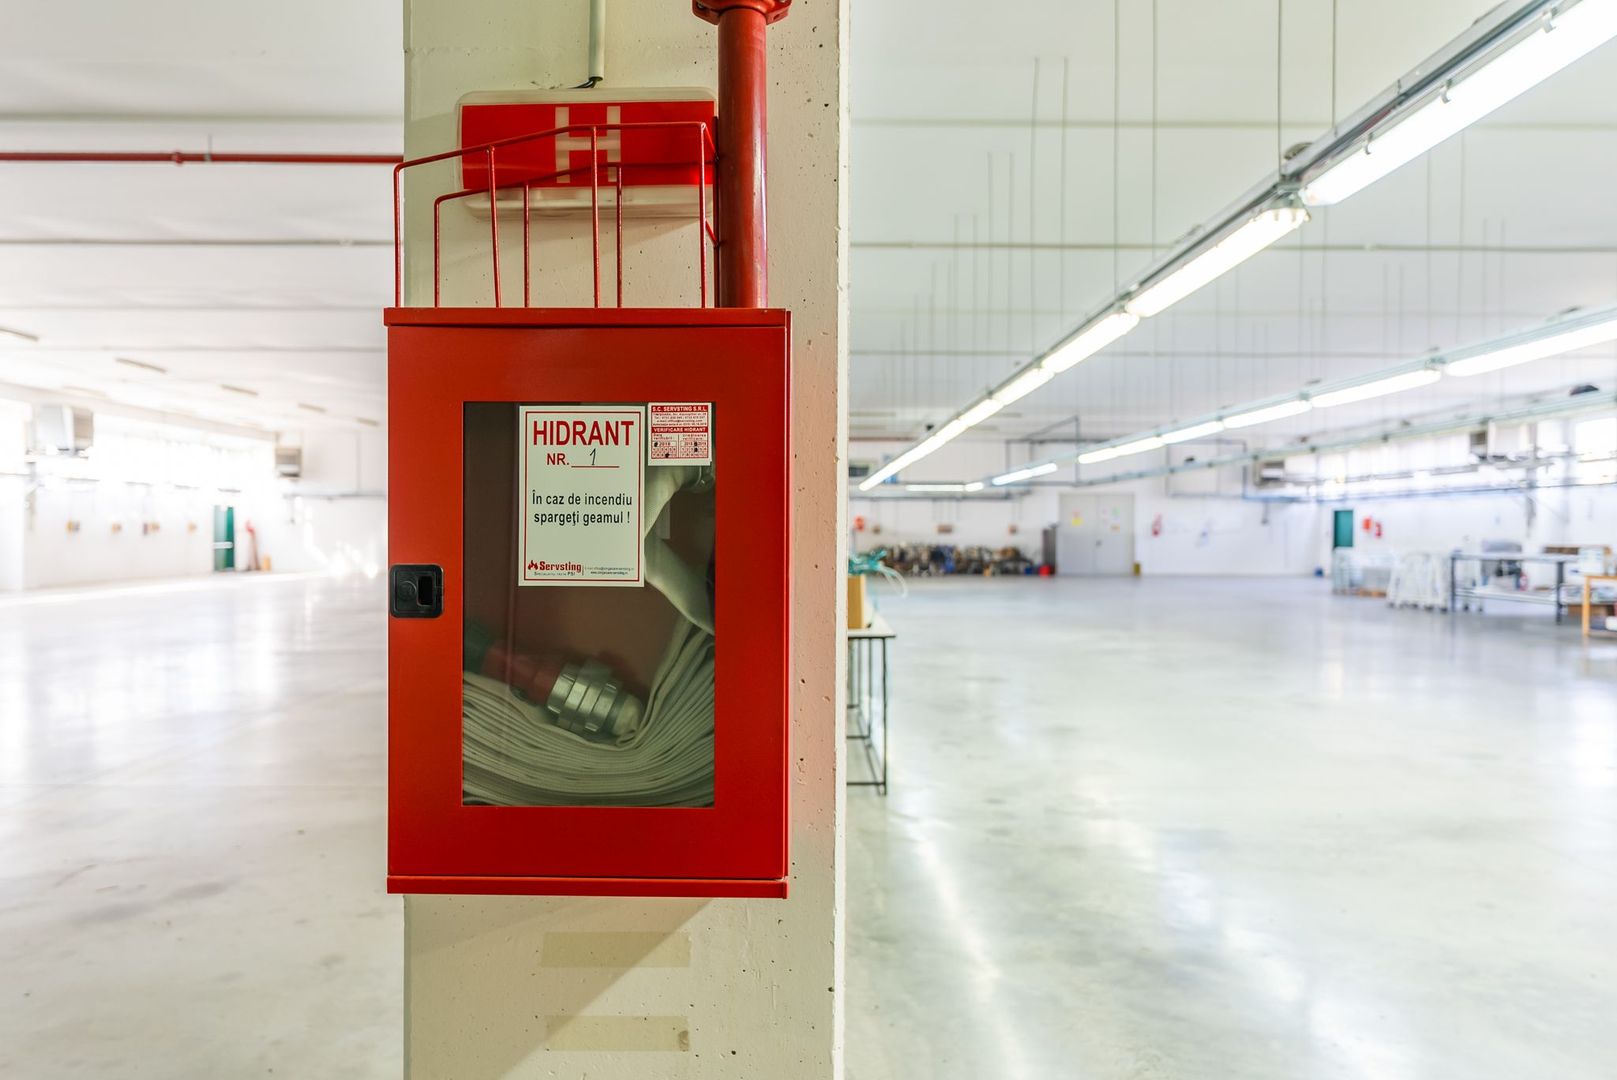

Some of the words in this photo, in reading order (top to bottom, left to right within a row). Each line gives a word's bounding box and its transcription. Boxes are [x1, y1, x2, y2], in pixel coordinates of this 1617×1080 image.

[533, 420, 634, 446] HIDRANT
[546, 453, 570, 466] NR.
[589, 448, 597, 466] 1
[532, 490, 542, 505] În
[546, 494, 565, 505] caz
[568, 493, 581, 505] de
[585, 493, 632, 506] incendiu
[583, 512, 623, 526] geamul
[627, 512, 630, 524] !
[539, 561, 581, 573] Servsting
